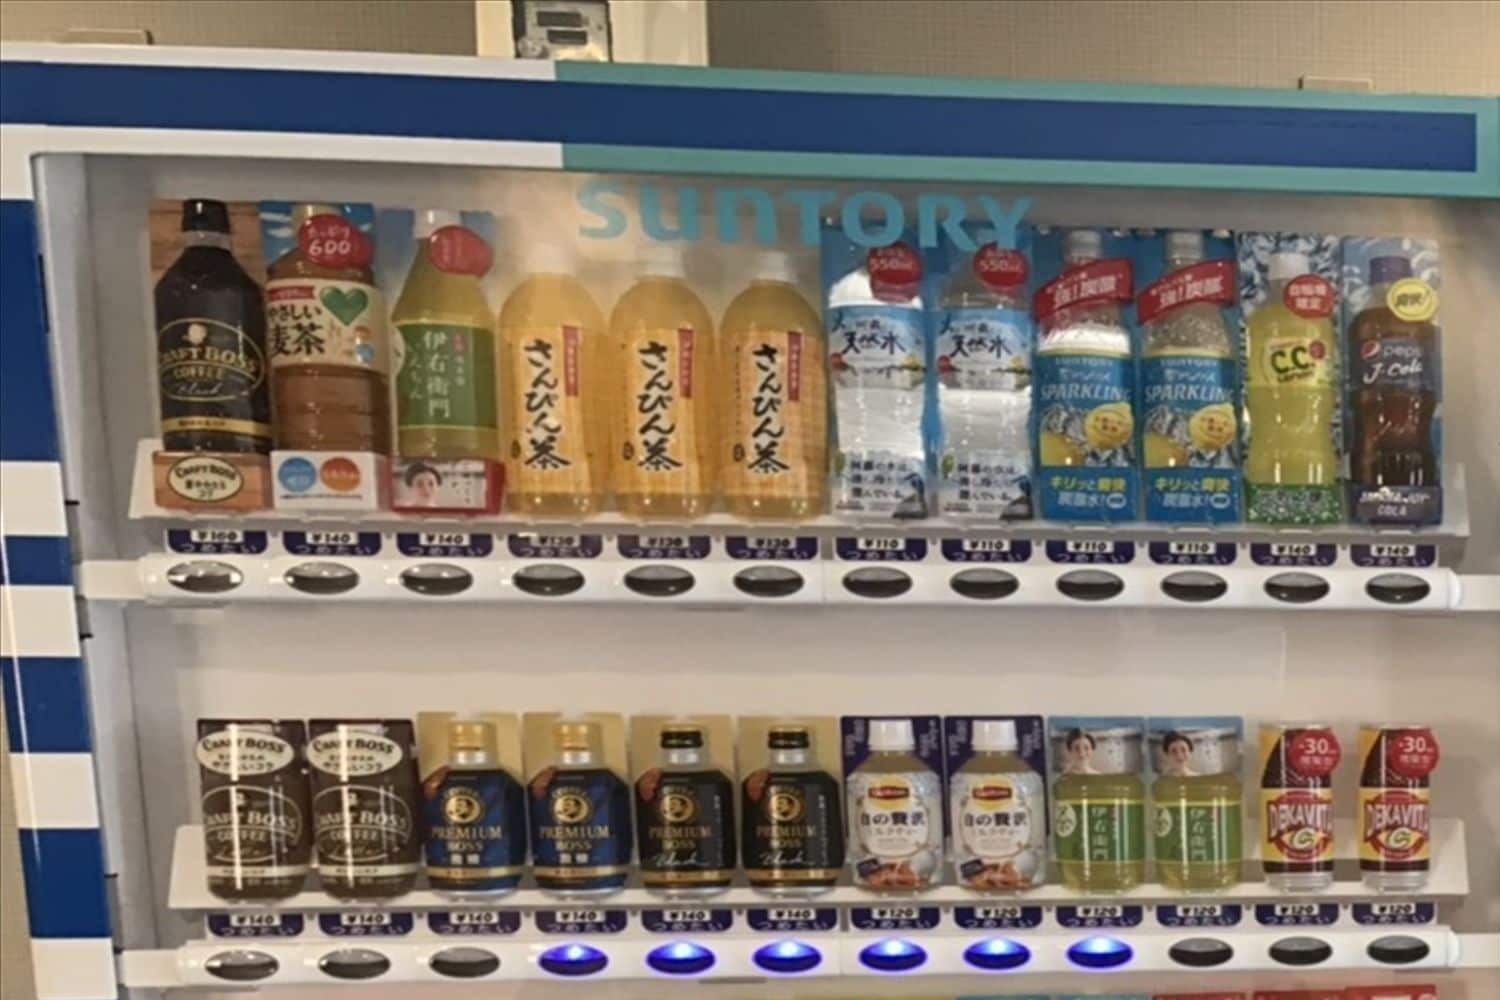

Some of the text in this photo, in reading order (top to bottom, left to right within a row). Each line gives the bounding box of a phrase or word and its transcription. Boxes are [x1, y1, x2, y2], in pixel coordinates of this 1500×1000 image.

[576, 181, 1034, 249] SUNTORY
[309, 240, 351, 256] 600
[268, 322, 325, 356] 麦茶
[841, 330, 907, 355] 天然水
[949, 334, 1013, 358] 天然水
[202, 738, 243, 753] CRAT
[312, 739, 353, 753] CRAT
